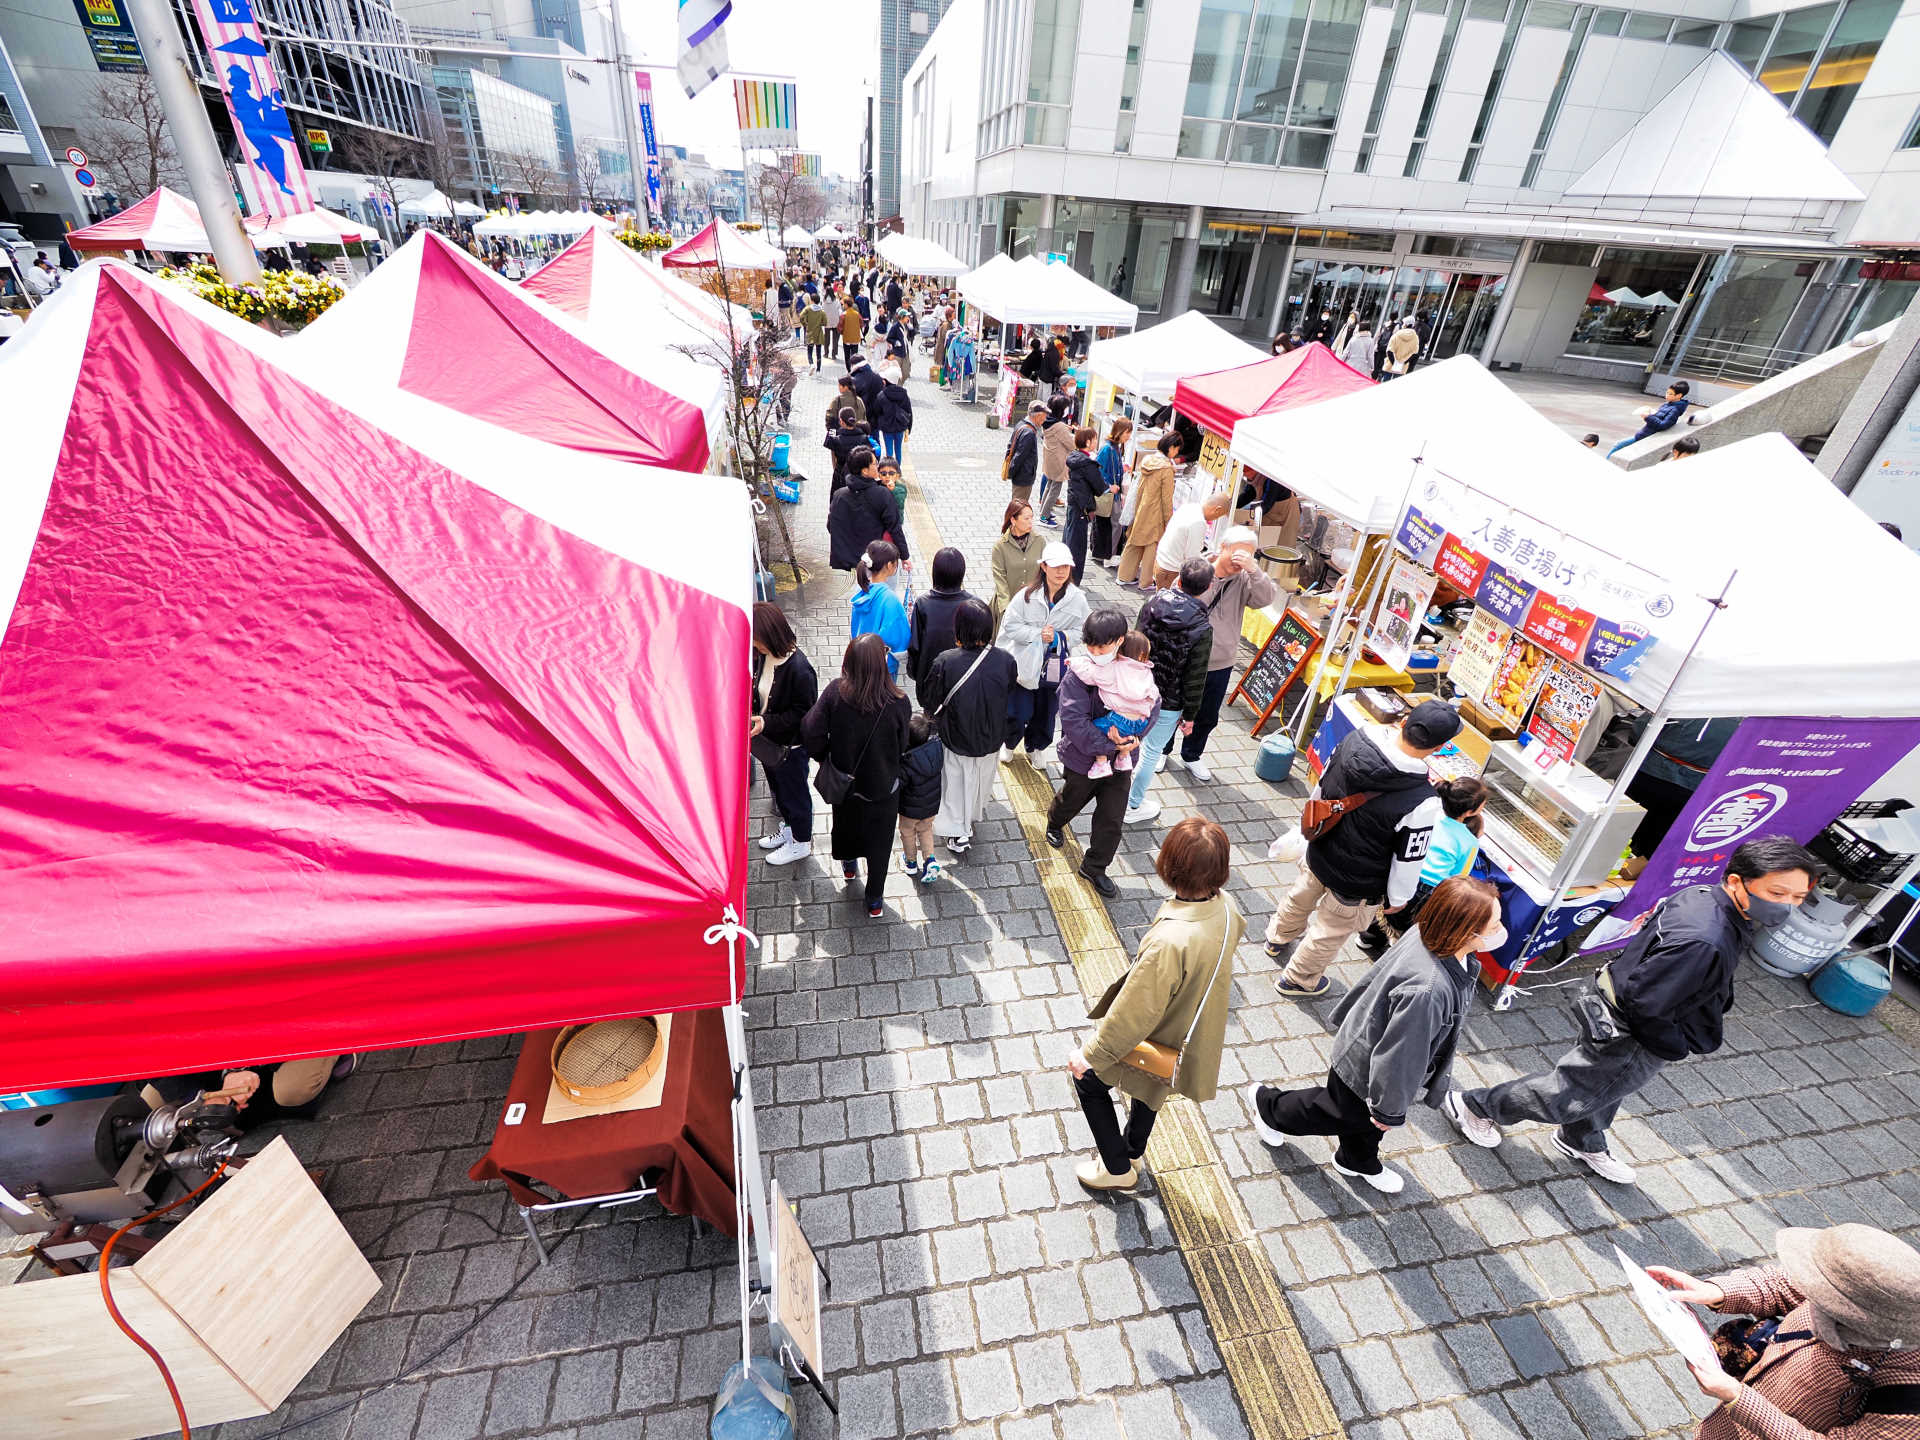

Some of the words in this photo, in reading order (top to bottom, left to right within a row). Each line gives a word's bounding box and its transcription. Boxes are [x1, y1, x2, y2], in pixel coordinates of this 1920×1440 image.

[87, 0, 111, 9] NPC
[95, 15, 114, 24] 24H
[308, 131, 326, 141] NPC
[71, 152, 84, 162] 30
[1471, 517, 1577, 588] 入善唐揚げ
